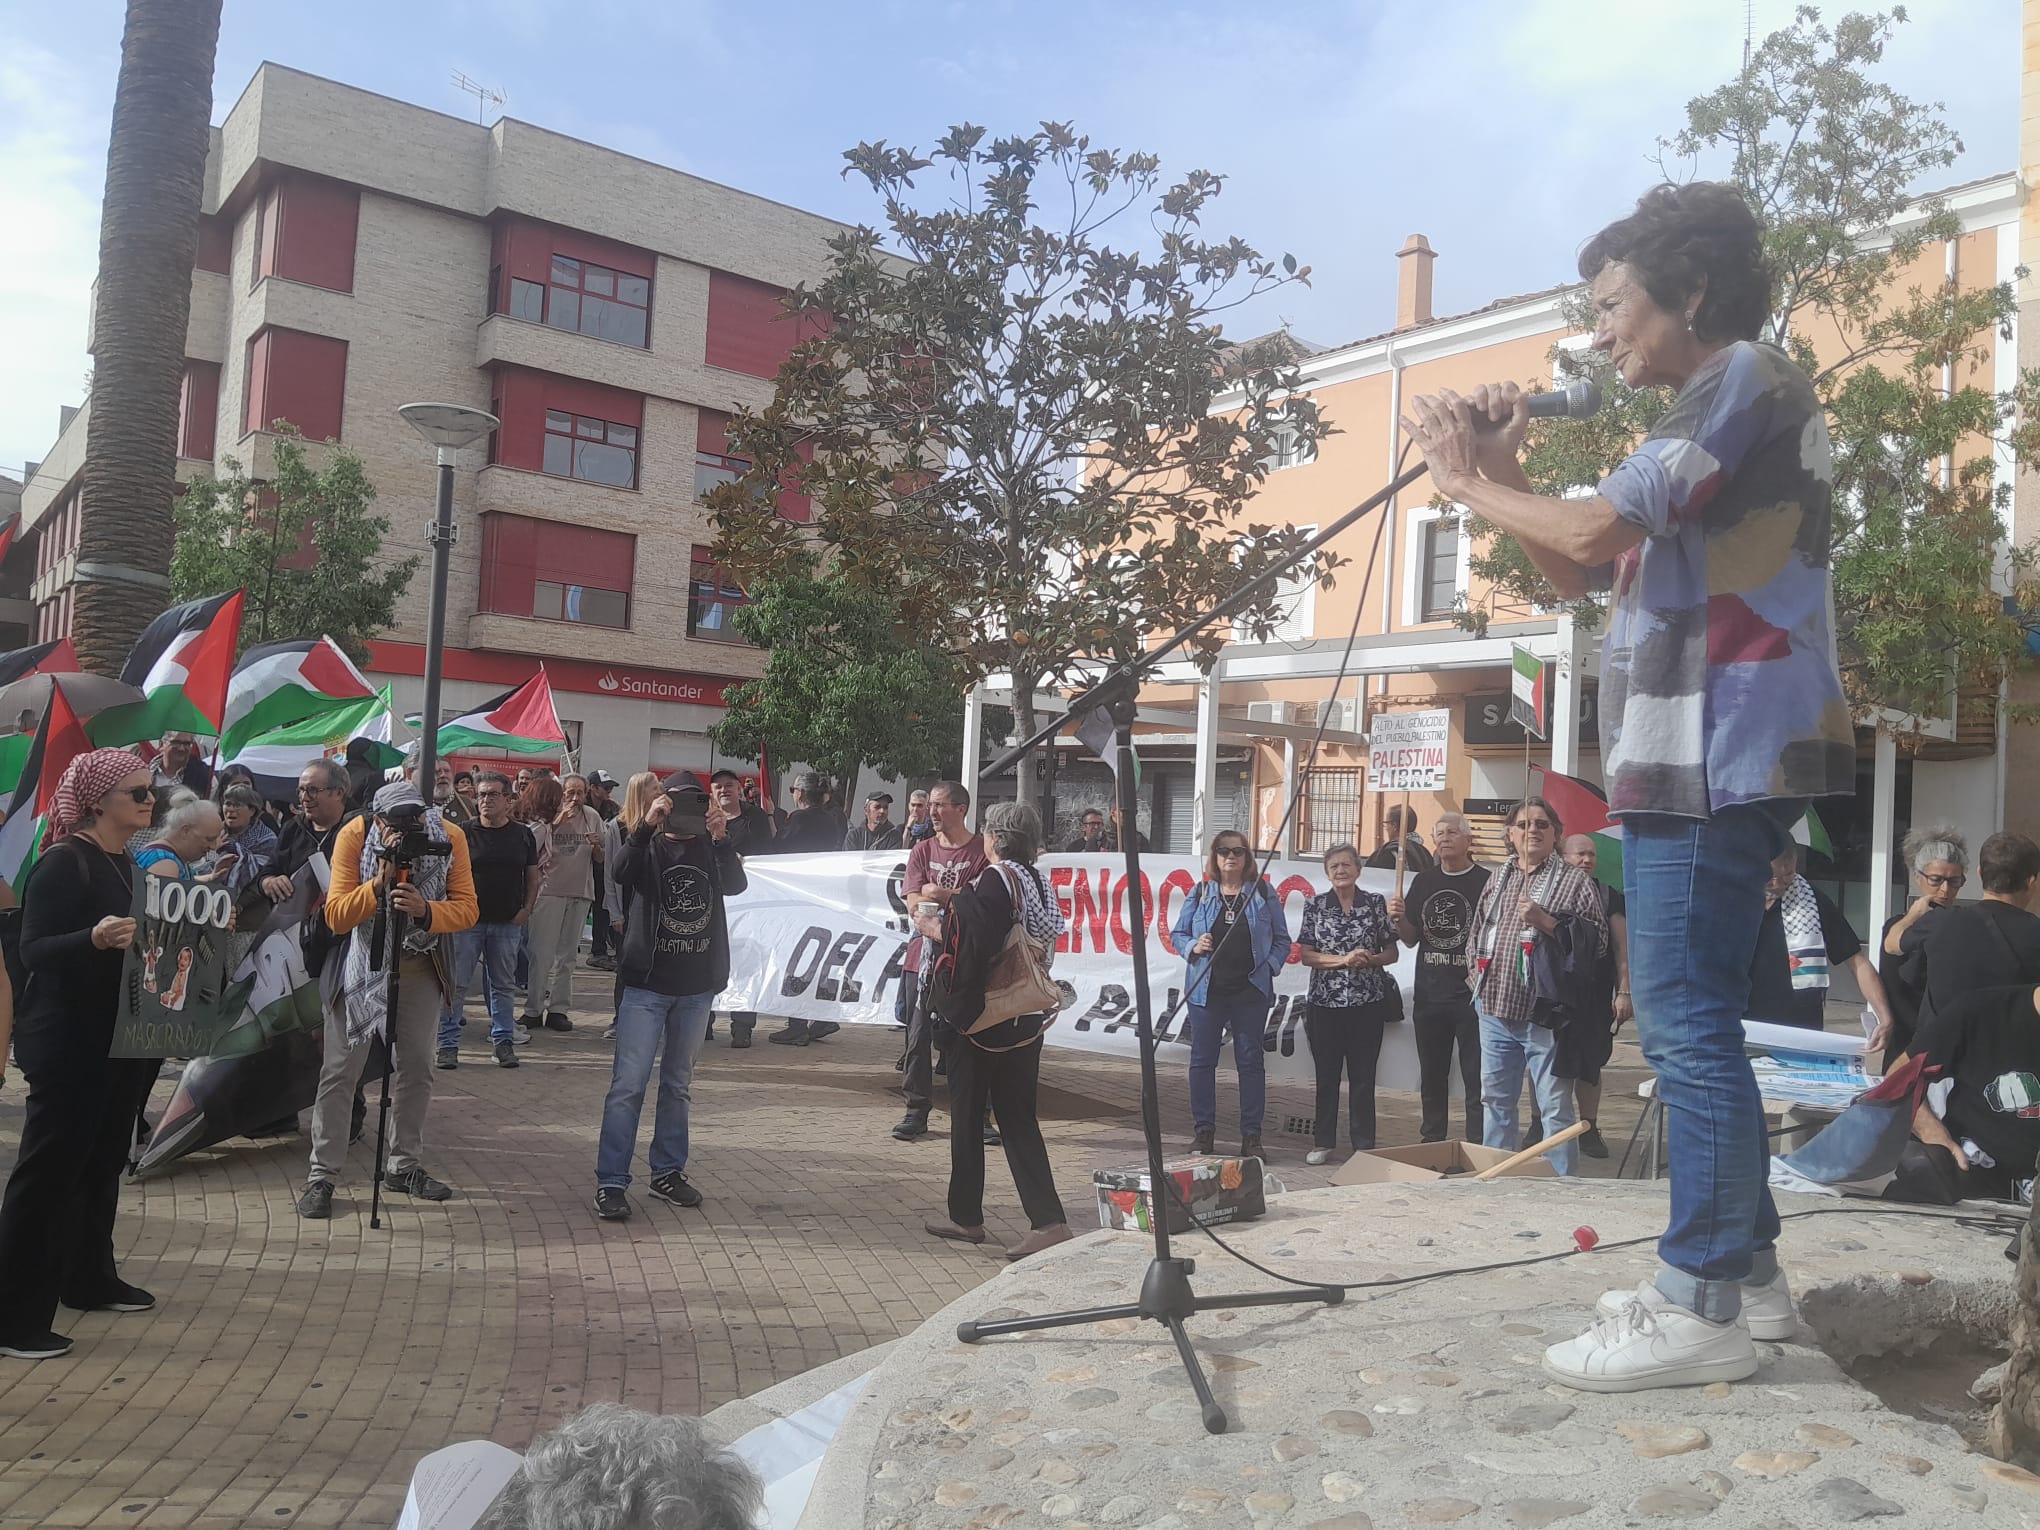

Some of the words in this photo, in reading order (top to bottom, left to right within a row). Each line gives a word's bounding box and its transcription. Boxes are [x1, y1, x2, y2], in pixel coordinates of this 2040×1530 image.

[622, 677, 703, 699] Santander
[1375, 720, 1393, 732] ALTO
[1394, 720, 1406, 730] AL
[1407, 716, 1447, 729] GENOCIDIO
[1371, 734, 1384, 745] DEL
[1386, 732, 1411, 743] PUEBLO
[1411, 730, 1447, 742] PALESTINO
[1372, 748, 1444, 769] PALESTINA
[1379, 768, 1434, 788] LIBRE
[781, 926, 878, 1003] DEL
